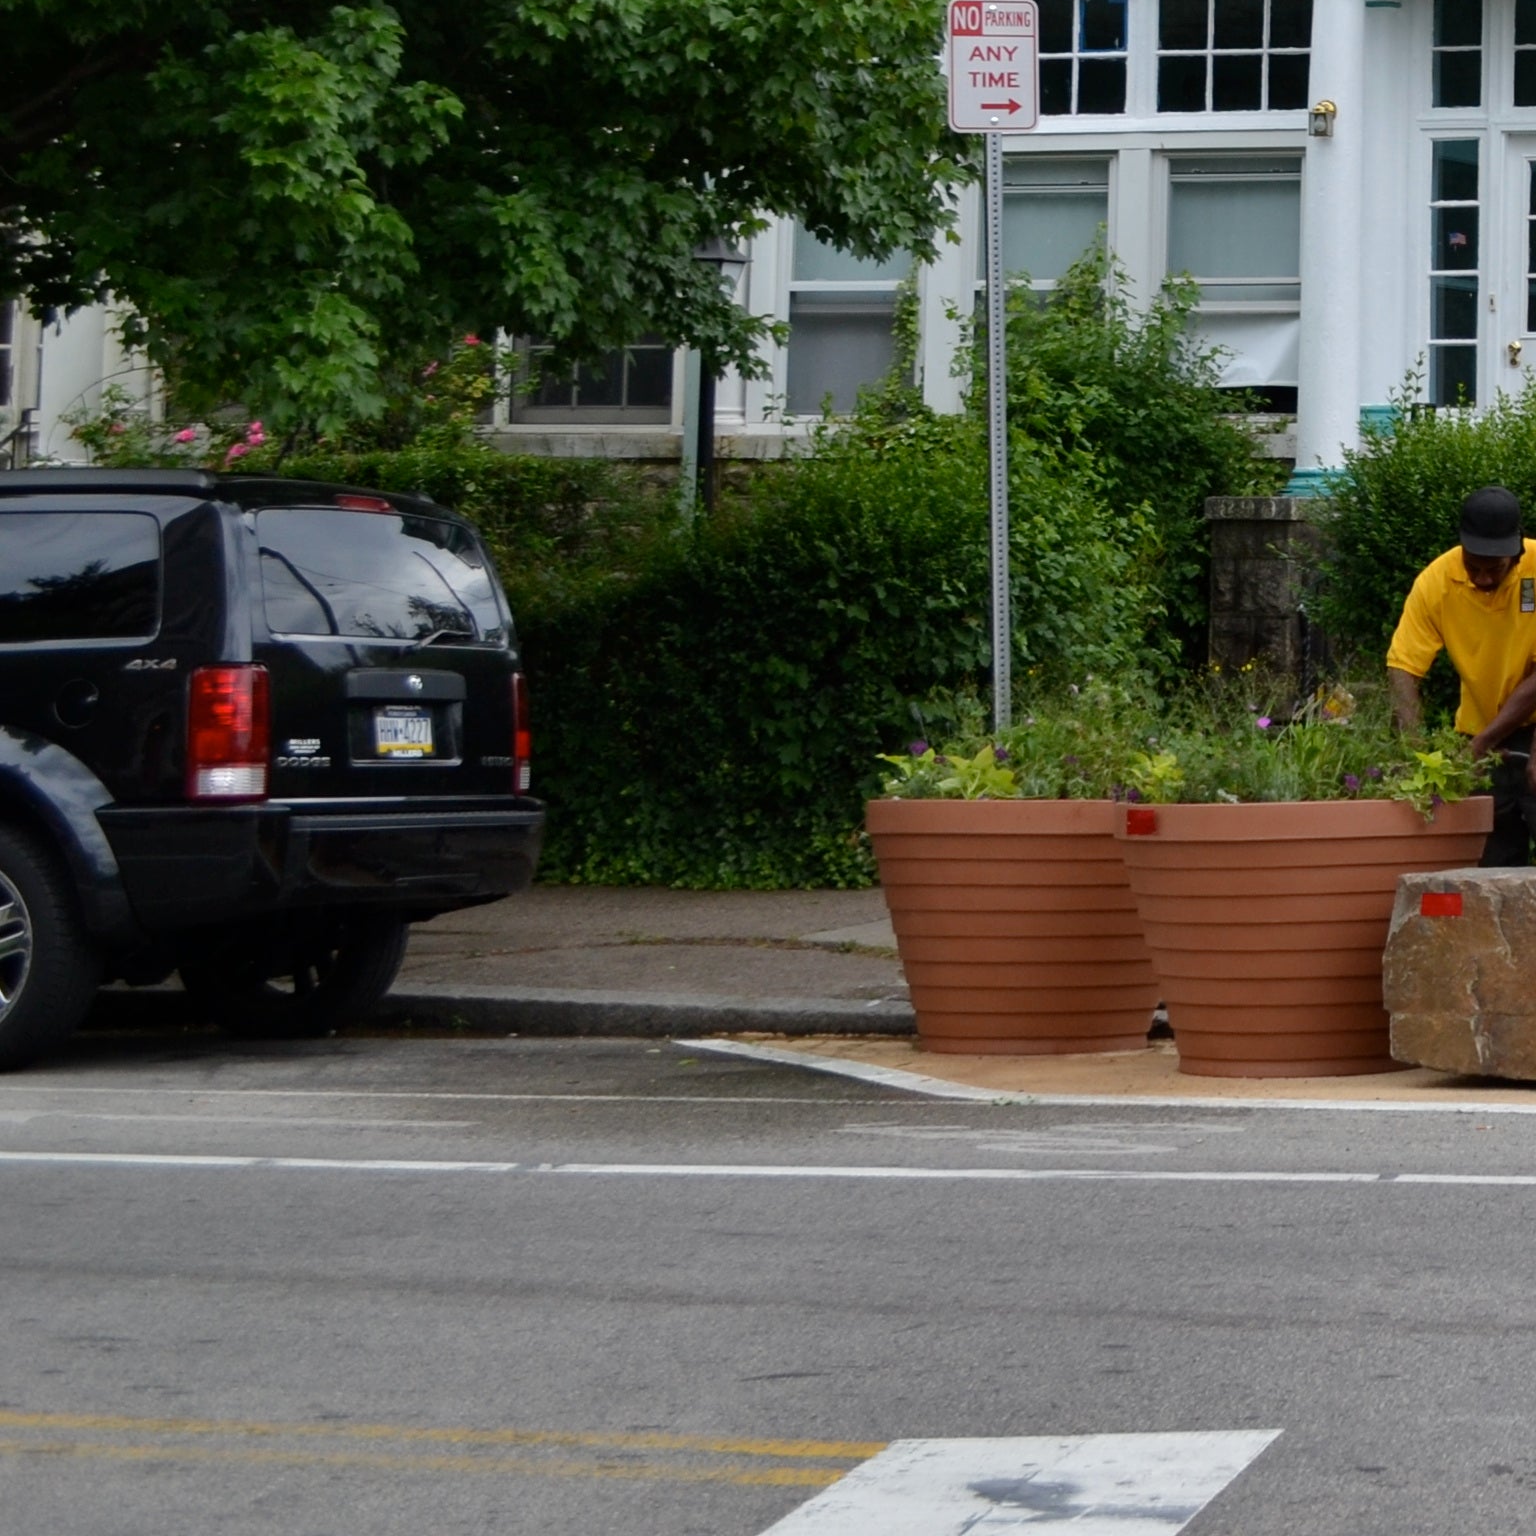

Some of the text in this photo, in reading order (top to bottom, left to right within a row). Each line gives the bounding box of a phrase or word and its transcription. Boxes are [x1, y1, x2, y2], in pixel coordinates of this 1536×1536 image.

[953, 5, 1031, 31] NO PARKING
[968, 45, 1019, 62] ANY
[967, 71, 1021, 88] TIME
[276, 756, 331, 767] DODGE
